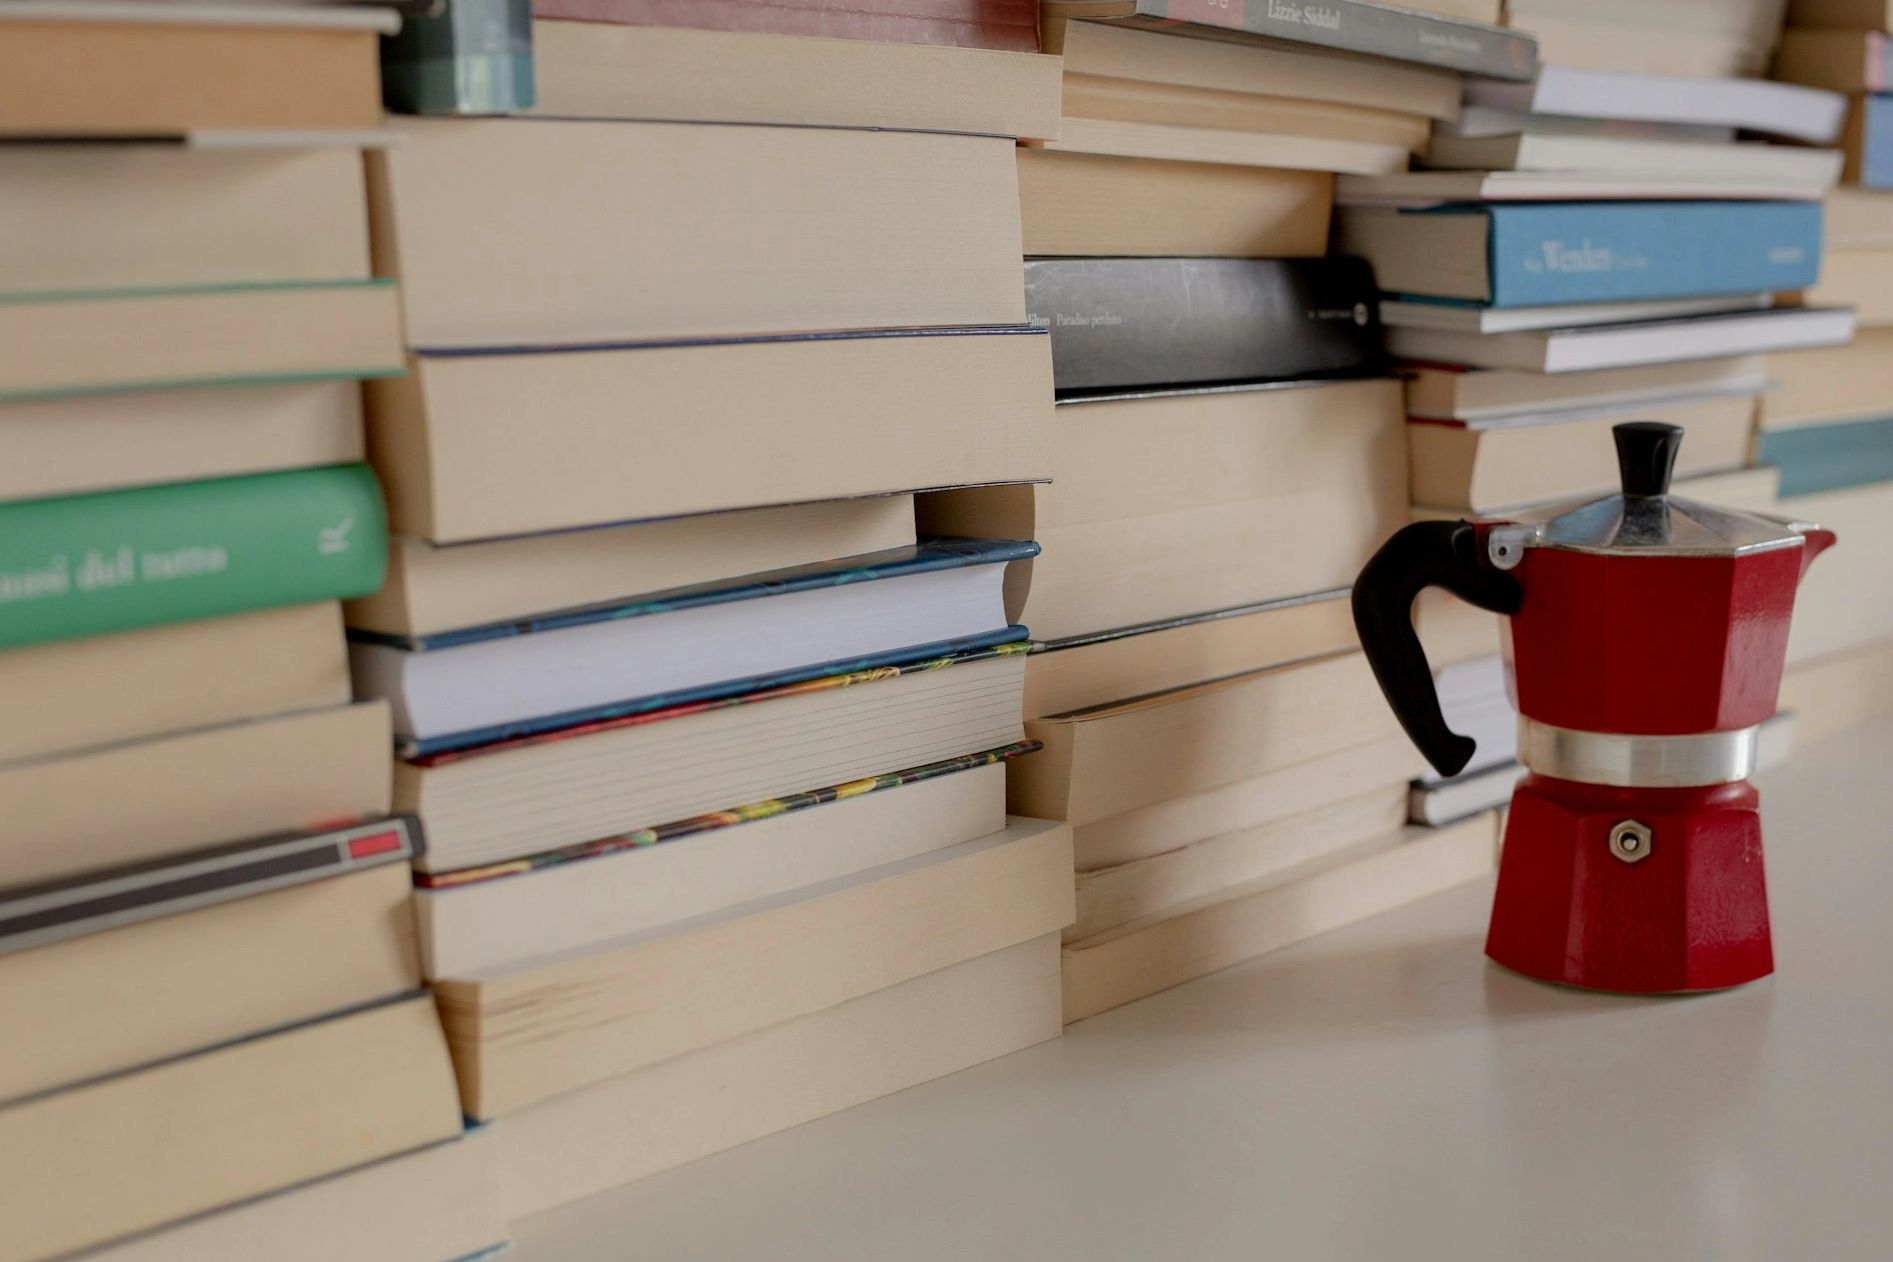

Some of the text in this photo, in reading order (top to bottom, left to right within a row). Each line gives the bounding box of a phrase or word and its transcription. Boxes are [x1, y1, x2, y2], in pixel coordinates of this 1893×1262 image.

[1268, 0, 1341, 29] Lizzie Siddal
[1056, 312, 1090, 326] Paradiso
